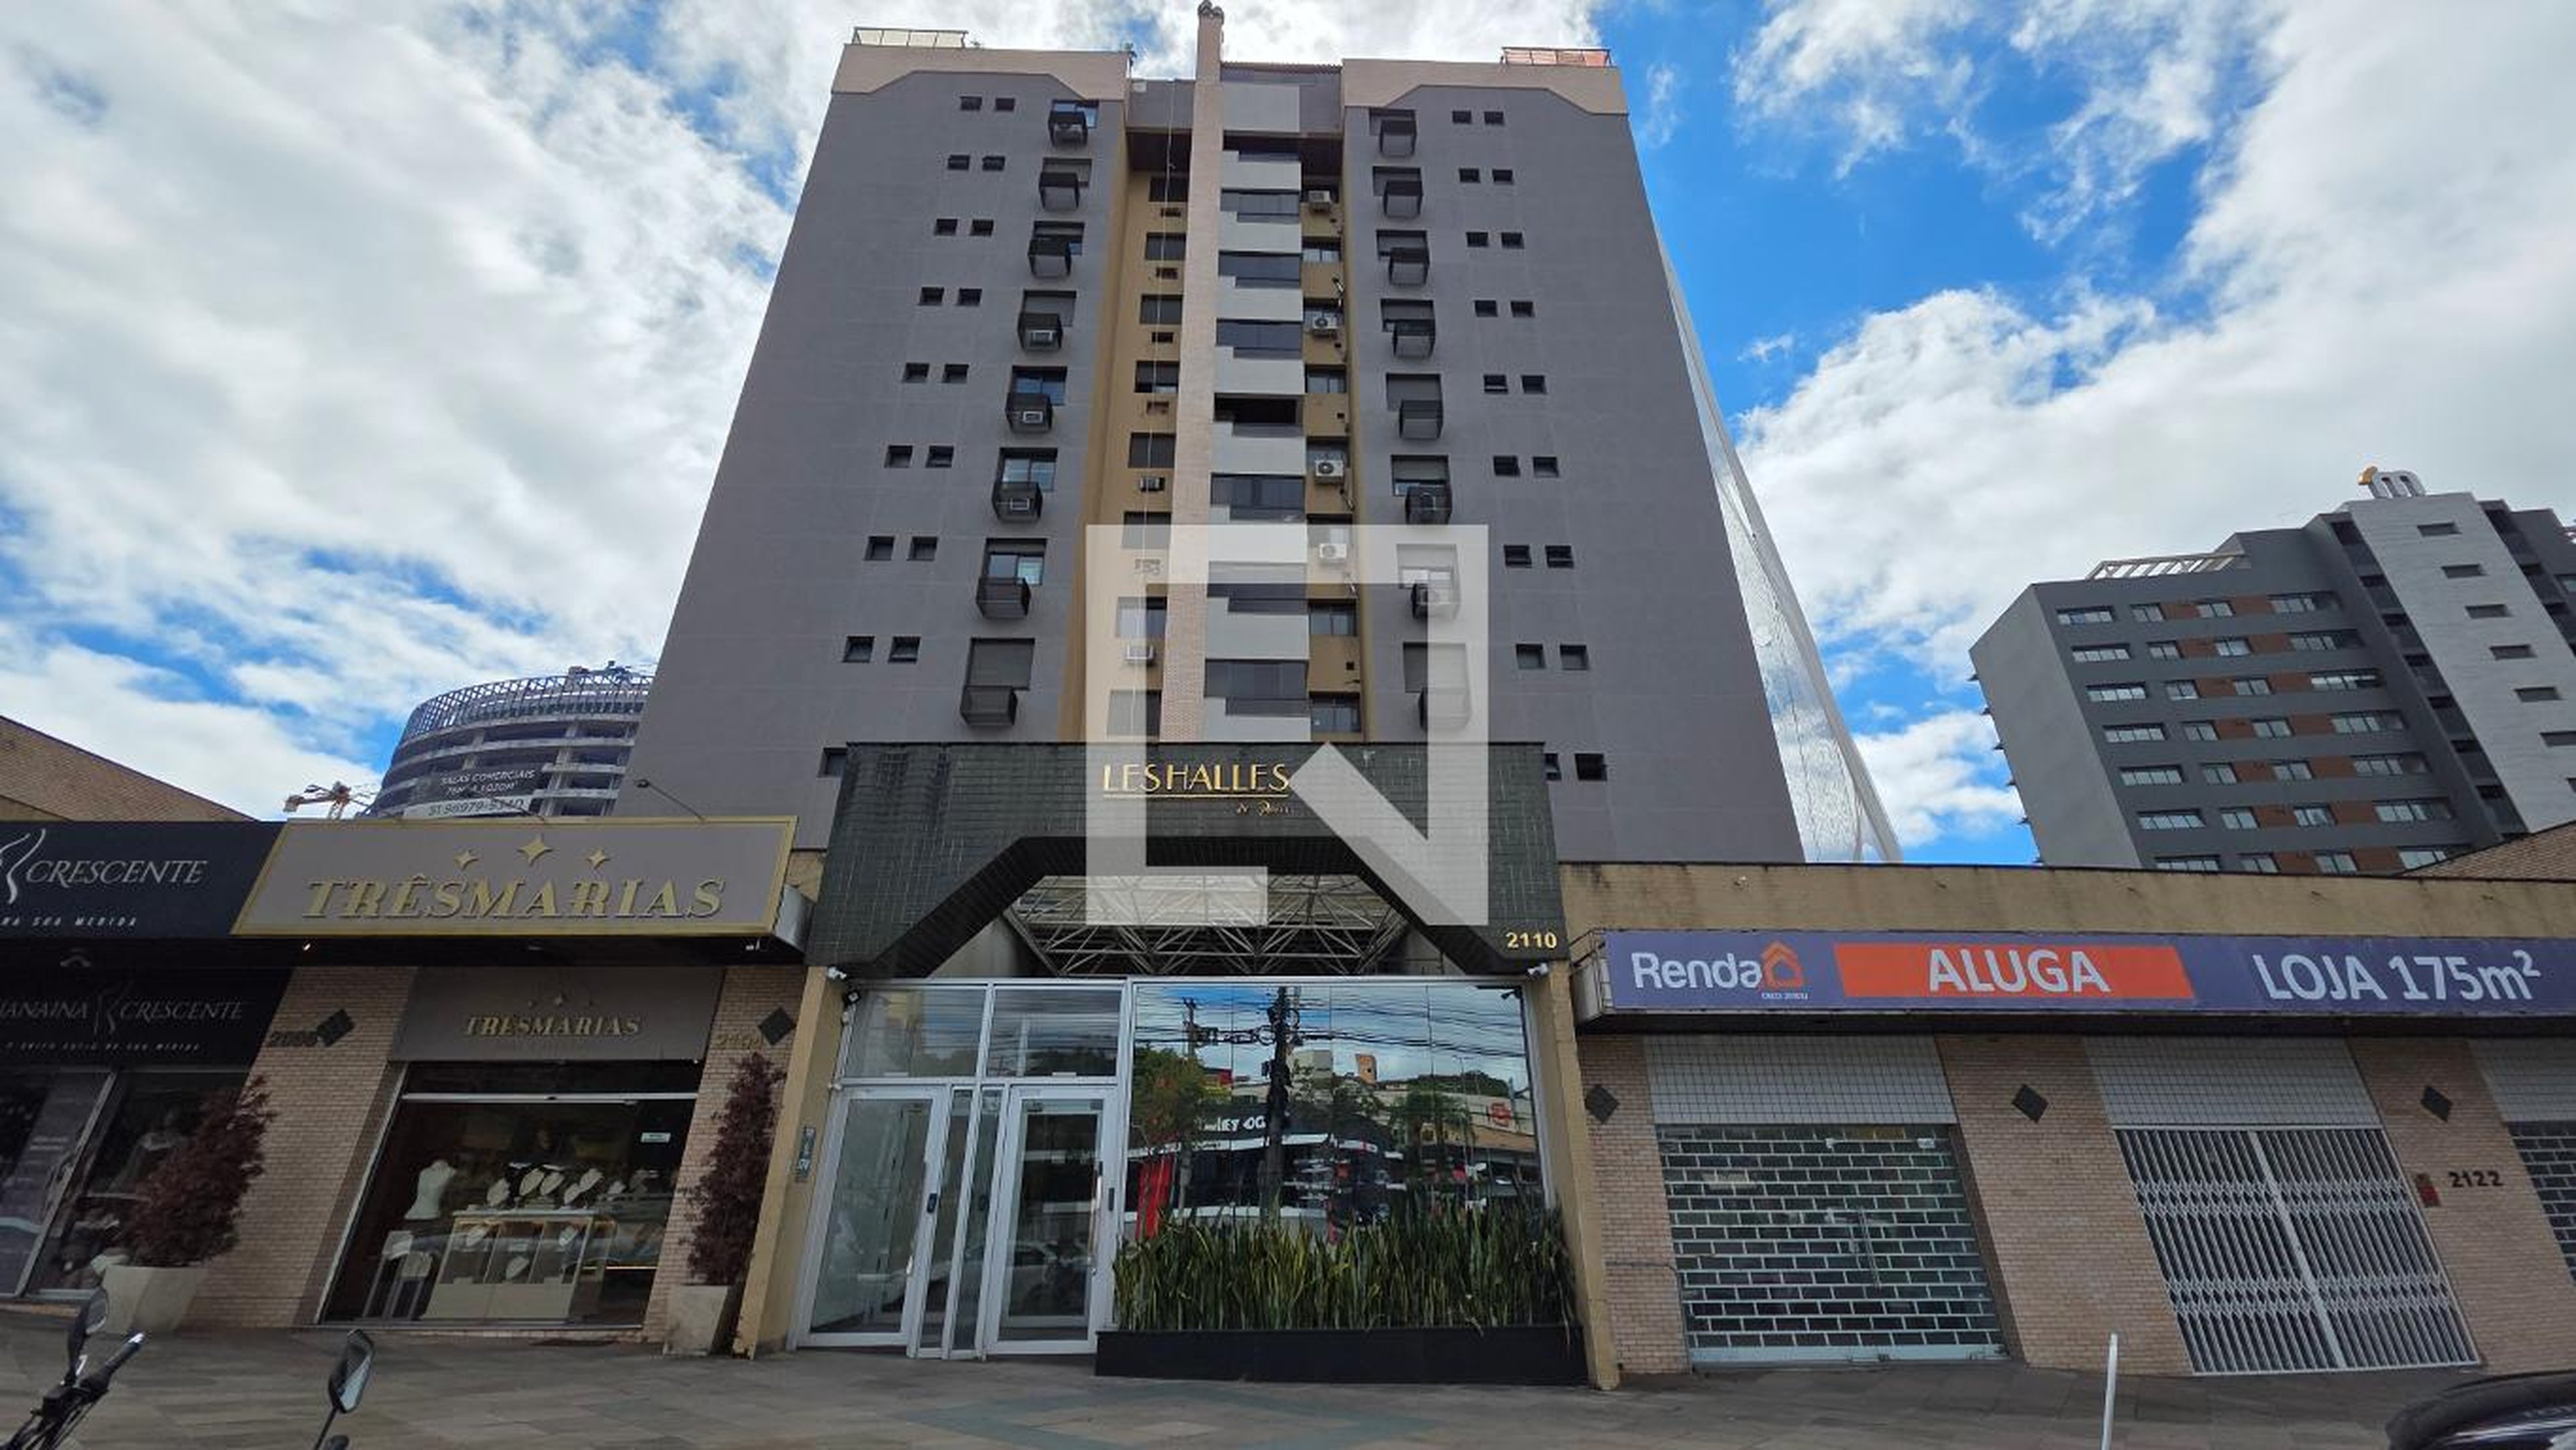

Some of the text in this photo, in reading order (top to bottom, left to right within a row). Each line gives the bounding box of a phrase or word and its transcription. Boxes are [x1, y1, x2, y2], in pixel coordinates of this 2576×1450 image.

[25, 858, 208, 889] CRESCENTE
[1505, 932, 1558, 950] 2110
[1630, 952, 1763, 989] Renda
[1928, 949, 2110, 993] ALUGA
[2251, 953, 2389, 1000] LOJA
[119, 1000, 244, 1023] CRESCENTE
[2447, 1170, 2505, 1188] 2122
